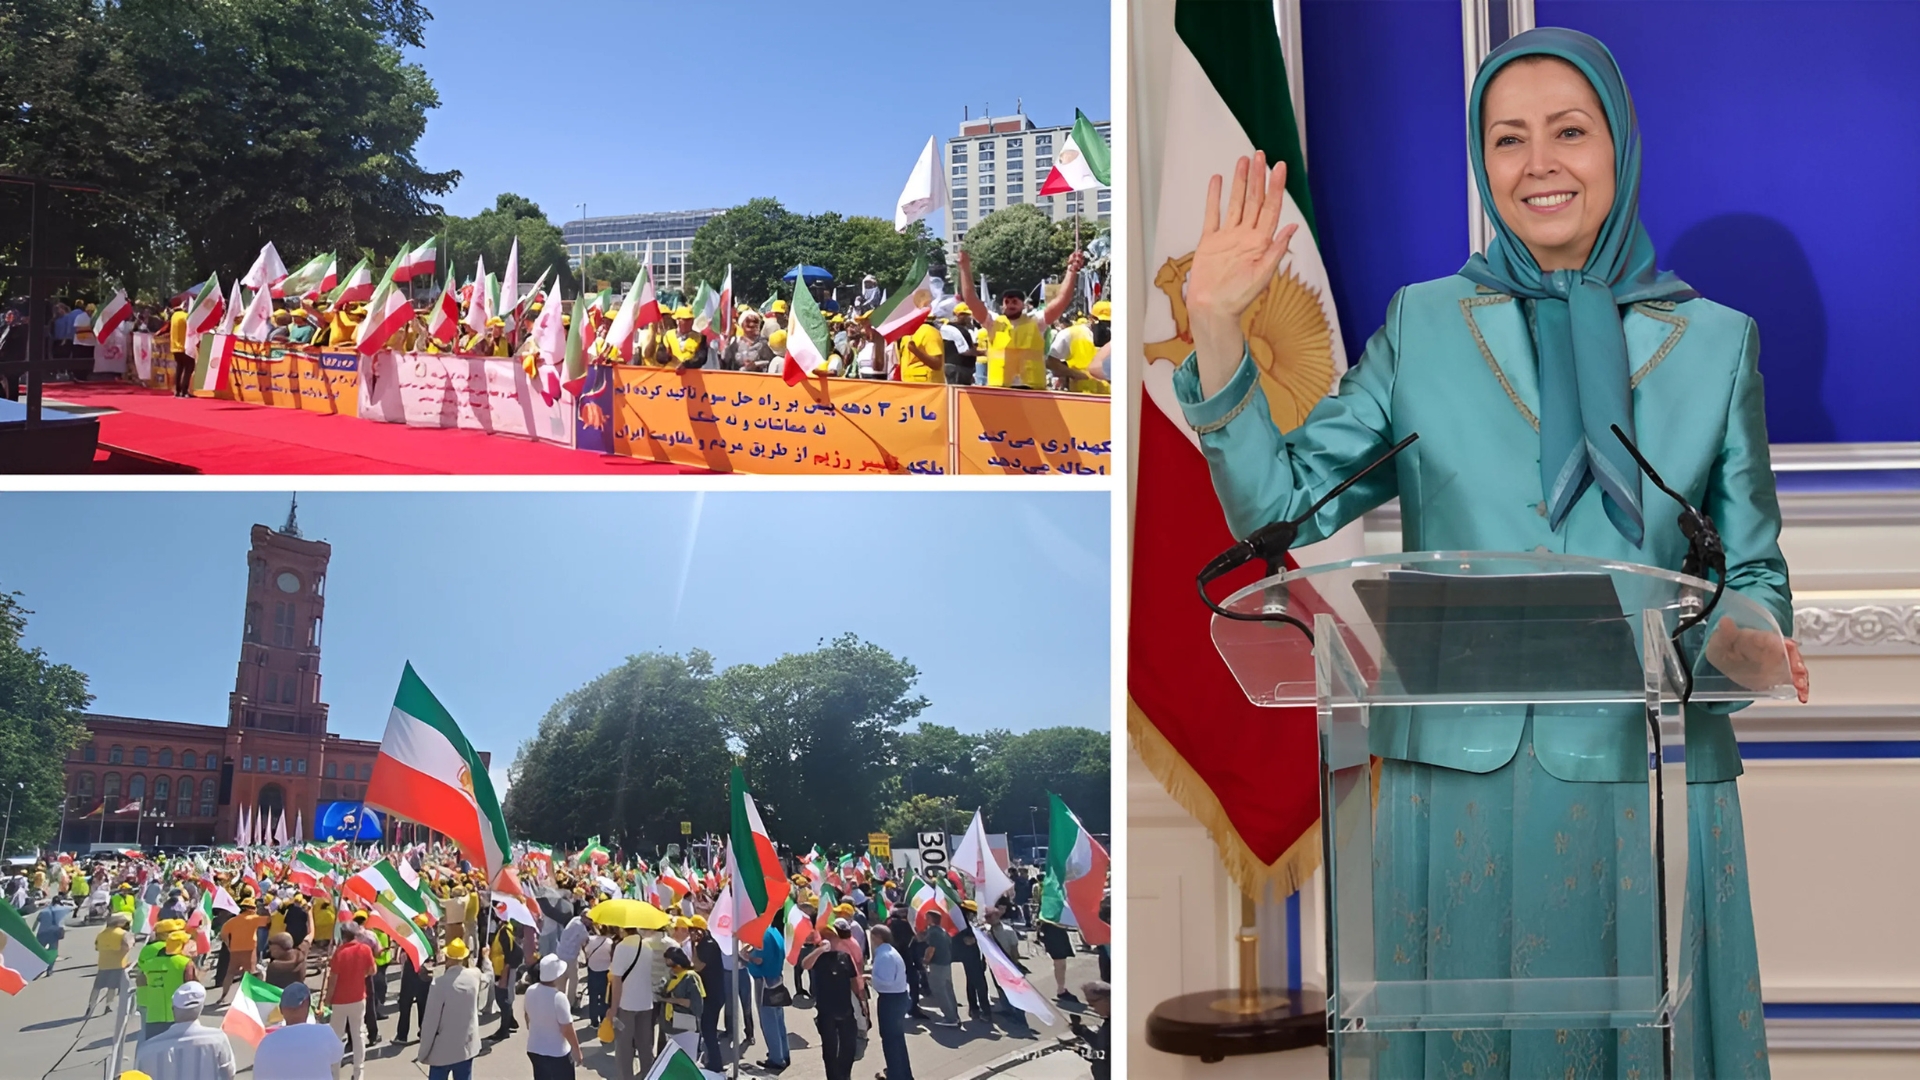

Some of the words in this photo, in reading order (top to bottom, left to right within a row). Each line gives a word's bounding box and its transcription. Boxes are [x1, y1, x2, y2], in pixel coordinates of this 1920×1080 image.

[701, 392, 726, 406] سوم
[731, 392, 753, 406] حل
[759, 394, 780, 410] راه
[842, 402, 872, 414] دهه
[898, 405, 914, 422] از
[920, 404, 937, 420] ما
[710, 438, 744, 454] مردم
[750, 443, 788, 458] طریق
[794, 446, 808, 462] از
[814, 451, 852, 469] رژیم
